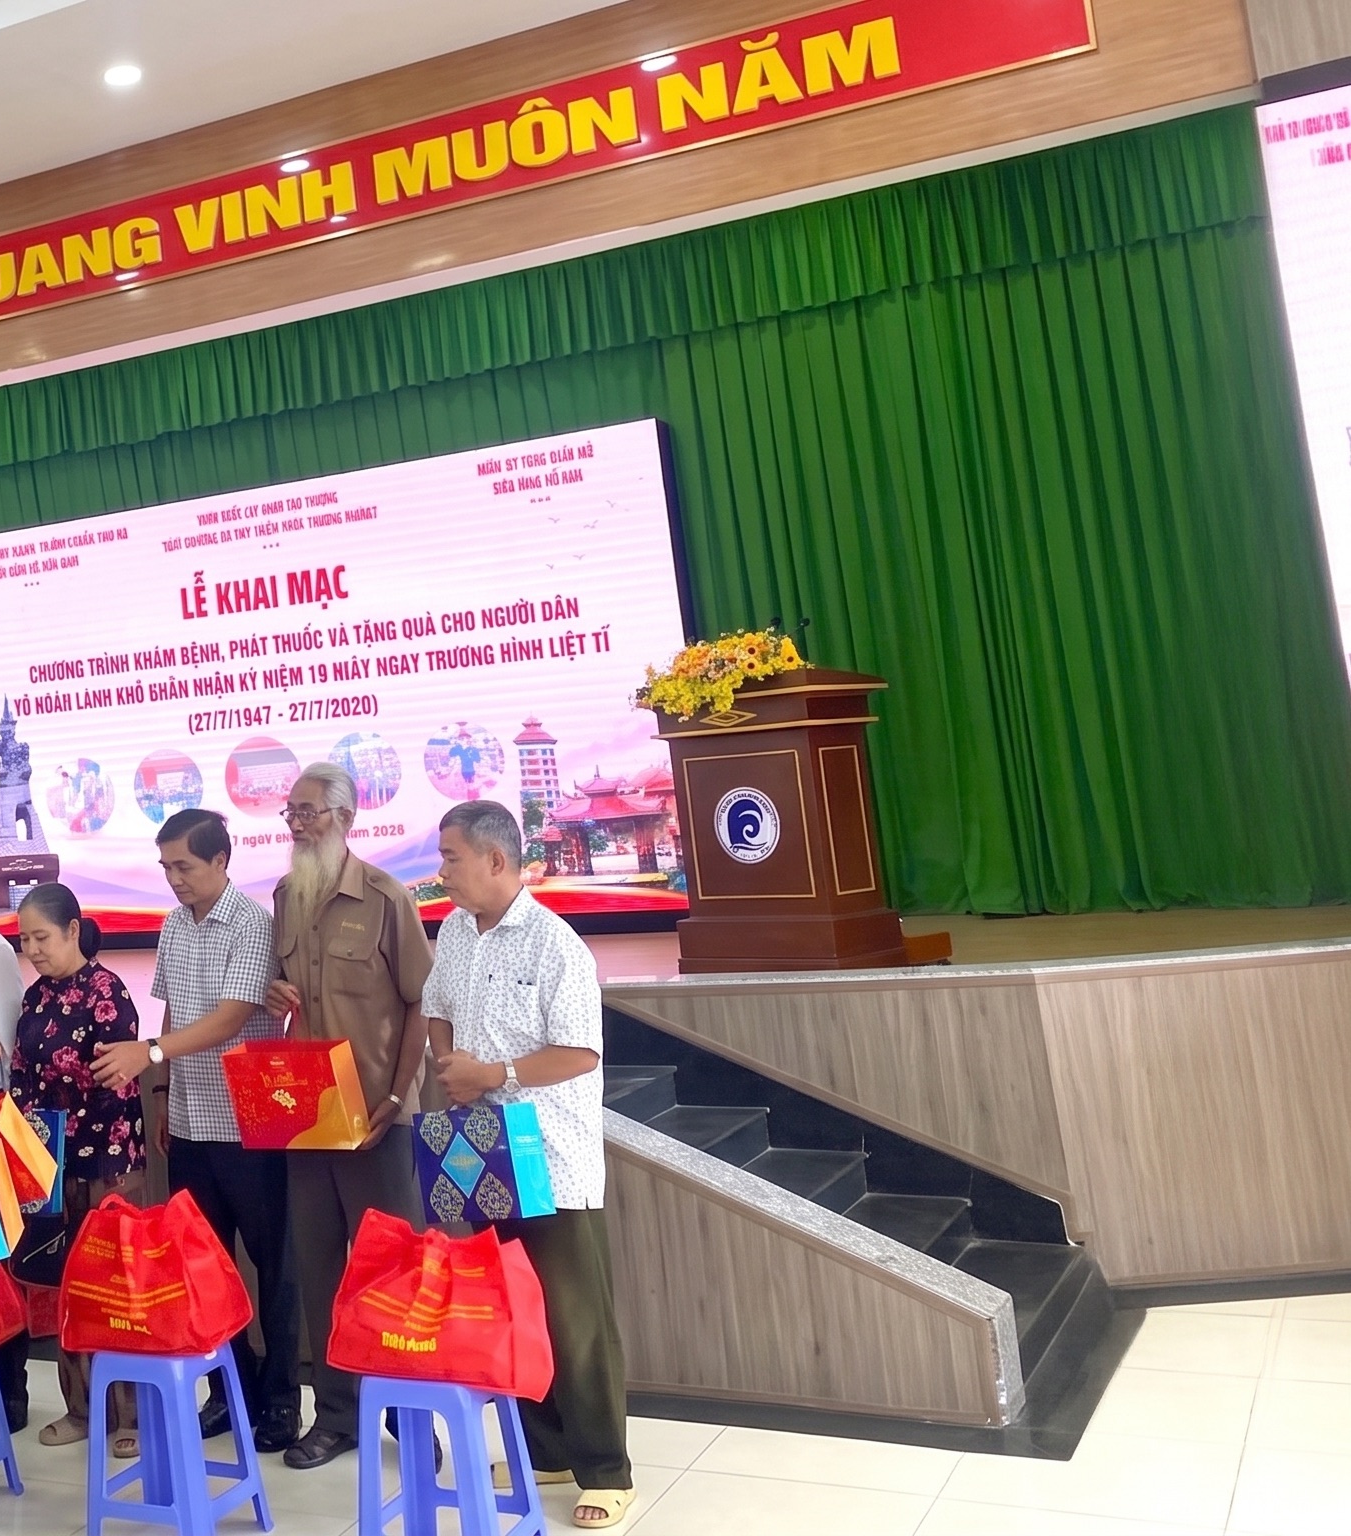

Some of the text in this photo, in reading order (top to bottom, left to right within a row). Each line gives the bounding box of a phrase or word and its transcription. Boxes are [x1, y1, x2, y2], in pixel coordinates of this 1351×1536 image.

[172, 161, 357, 255] VINH
[372, 86, 643, 206] MUÔN
[656, 15, 901, 133] NĂM
[181, 565, 349, 620] LỄ KHAI MẠC
[30, 595, 580, 684] CHƯƠNG TRÌNH KHÁM BỆNH, PHÁT THUỐC VÀ TẶNG QUÀ CHO NGƯỜI DÂN
[193, 671, 235, 699] NHẬN
[239, 667, 258, 692] KÝ
[263, 664, 304, 693] NIỆM
[309, 664, 328, 684] 19
[376, 653, 420, 677] NGAY
[426, 645, 495, 672] TRƯƠNG
[500, 637, 544, 664] HÌNH
[549, 630, 586, 662] LIỆT
[189, 706, 271, 736] (27/7/1947
[289, 694, 378, 722] 27/7/2020)
